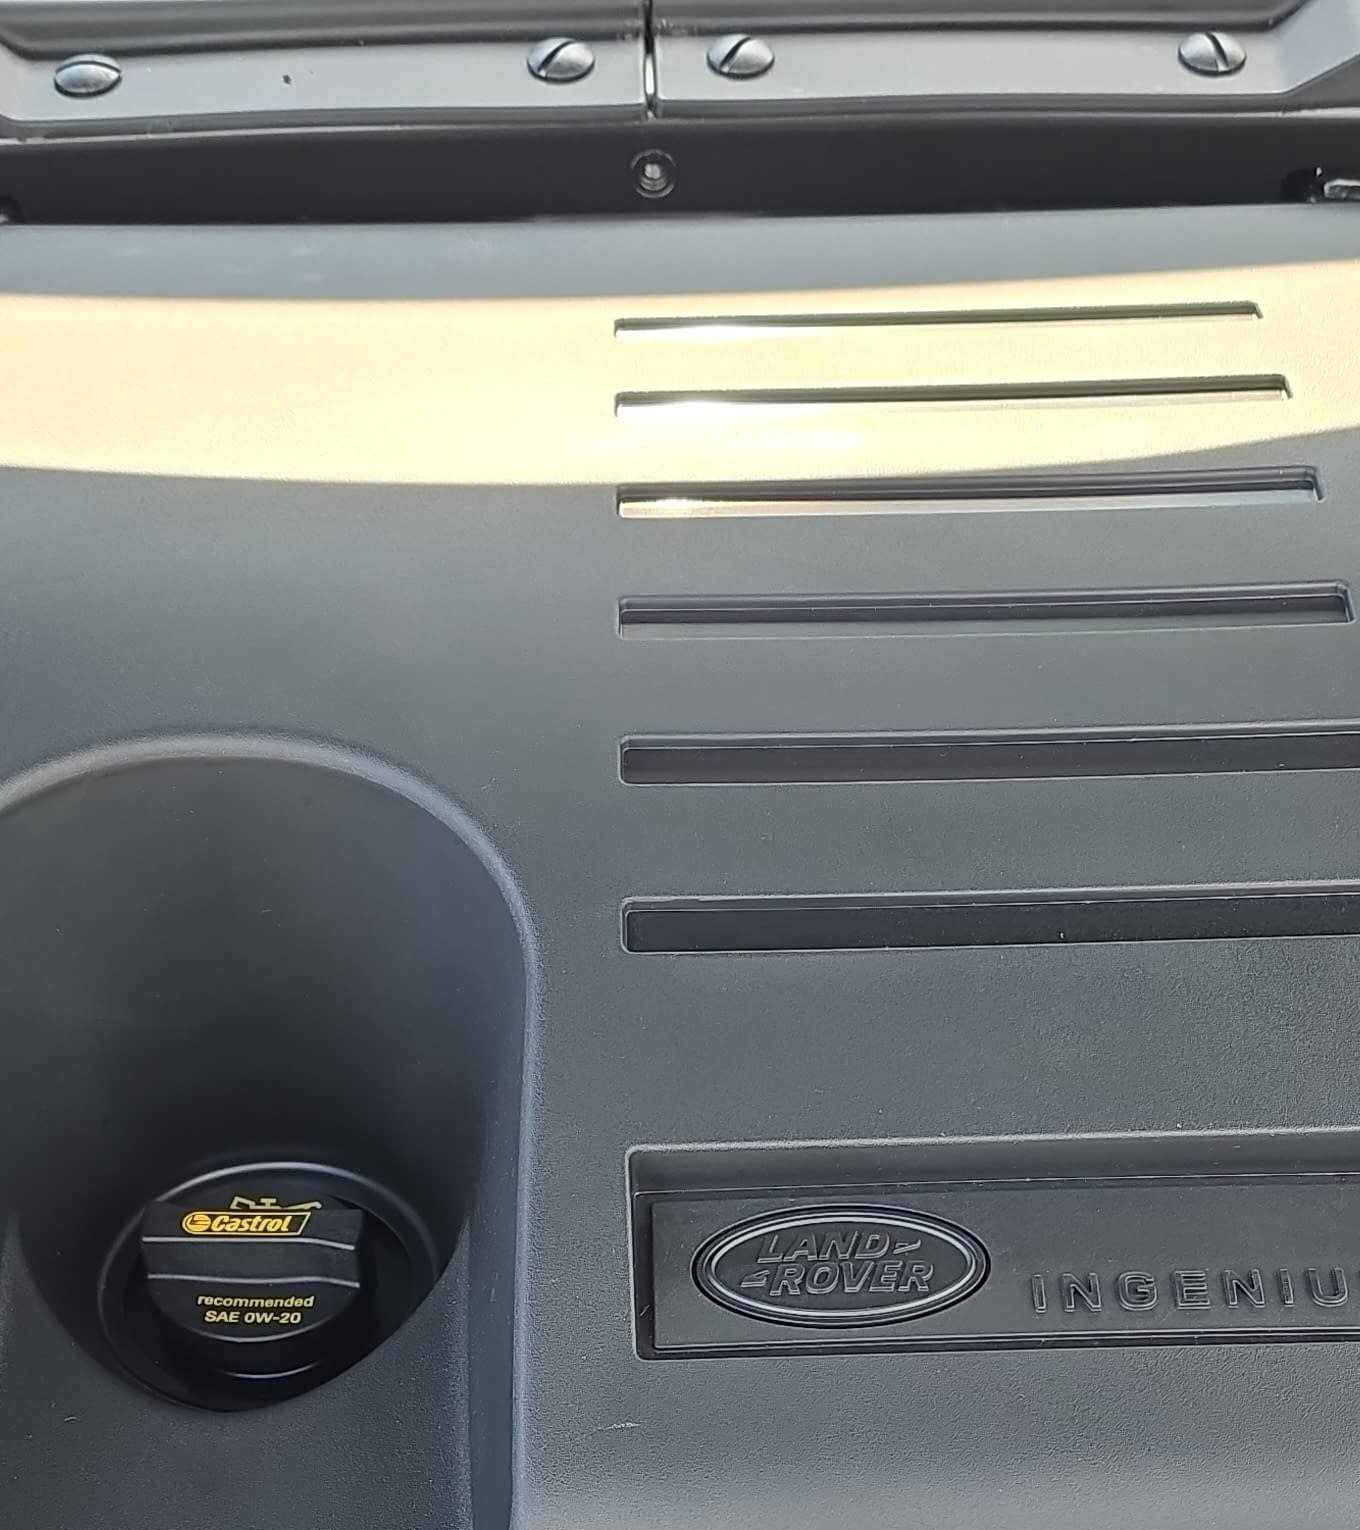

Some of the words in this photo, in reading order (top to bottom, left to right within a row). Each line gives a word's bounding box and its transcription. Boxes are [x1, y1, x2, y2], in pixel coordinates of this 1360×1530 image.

[210, 1213, 293, 1233] Castrol
[197, 1296, 316, 1309] recommended
[204, 1310, 240, 1324] SAE
[243, 1311, 302, 1325] 0W-20
